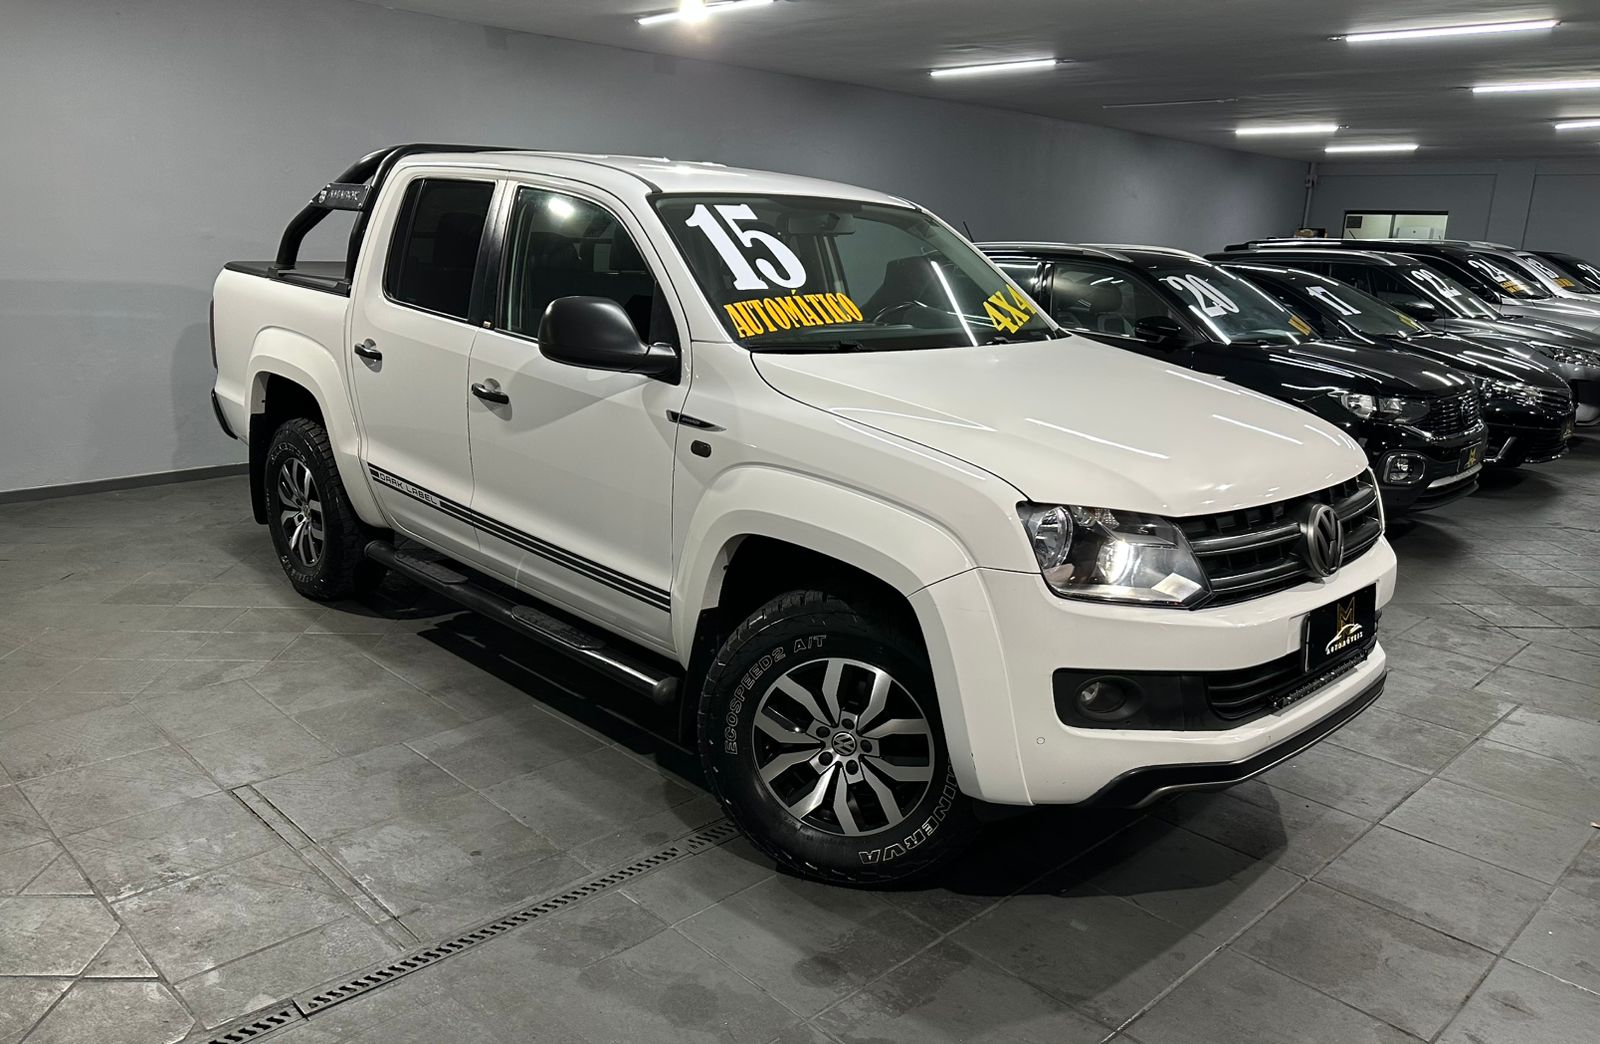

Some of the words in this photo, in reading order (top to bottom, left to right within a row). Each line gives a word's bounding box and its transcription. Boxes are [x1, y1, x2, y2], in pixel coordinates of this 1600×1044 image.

[685, 204, 806, 290] 15
[1411, 268, 1462, 299] 22
[1467, 258, 1517, 283] 24
[723, 289, 863, 338] AUTOMÁTICO
[983, 284, 1037, 334] 4X4
[1159, 274, 1240, 317] 20
[1305, 286, 1361, 316] 17
[380, 472, 404, 490] DARK
[406, 484, 437, 505] LABEL
[725, 646, 786, 754] ECOSPEED2
[793, 634, 827, 653] A/T
